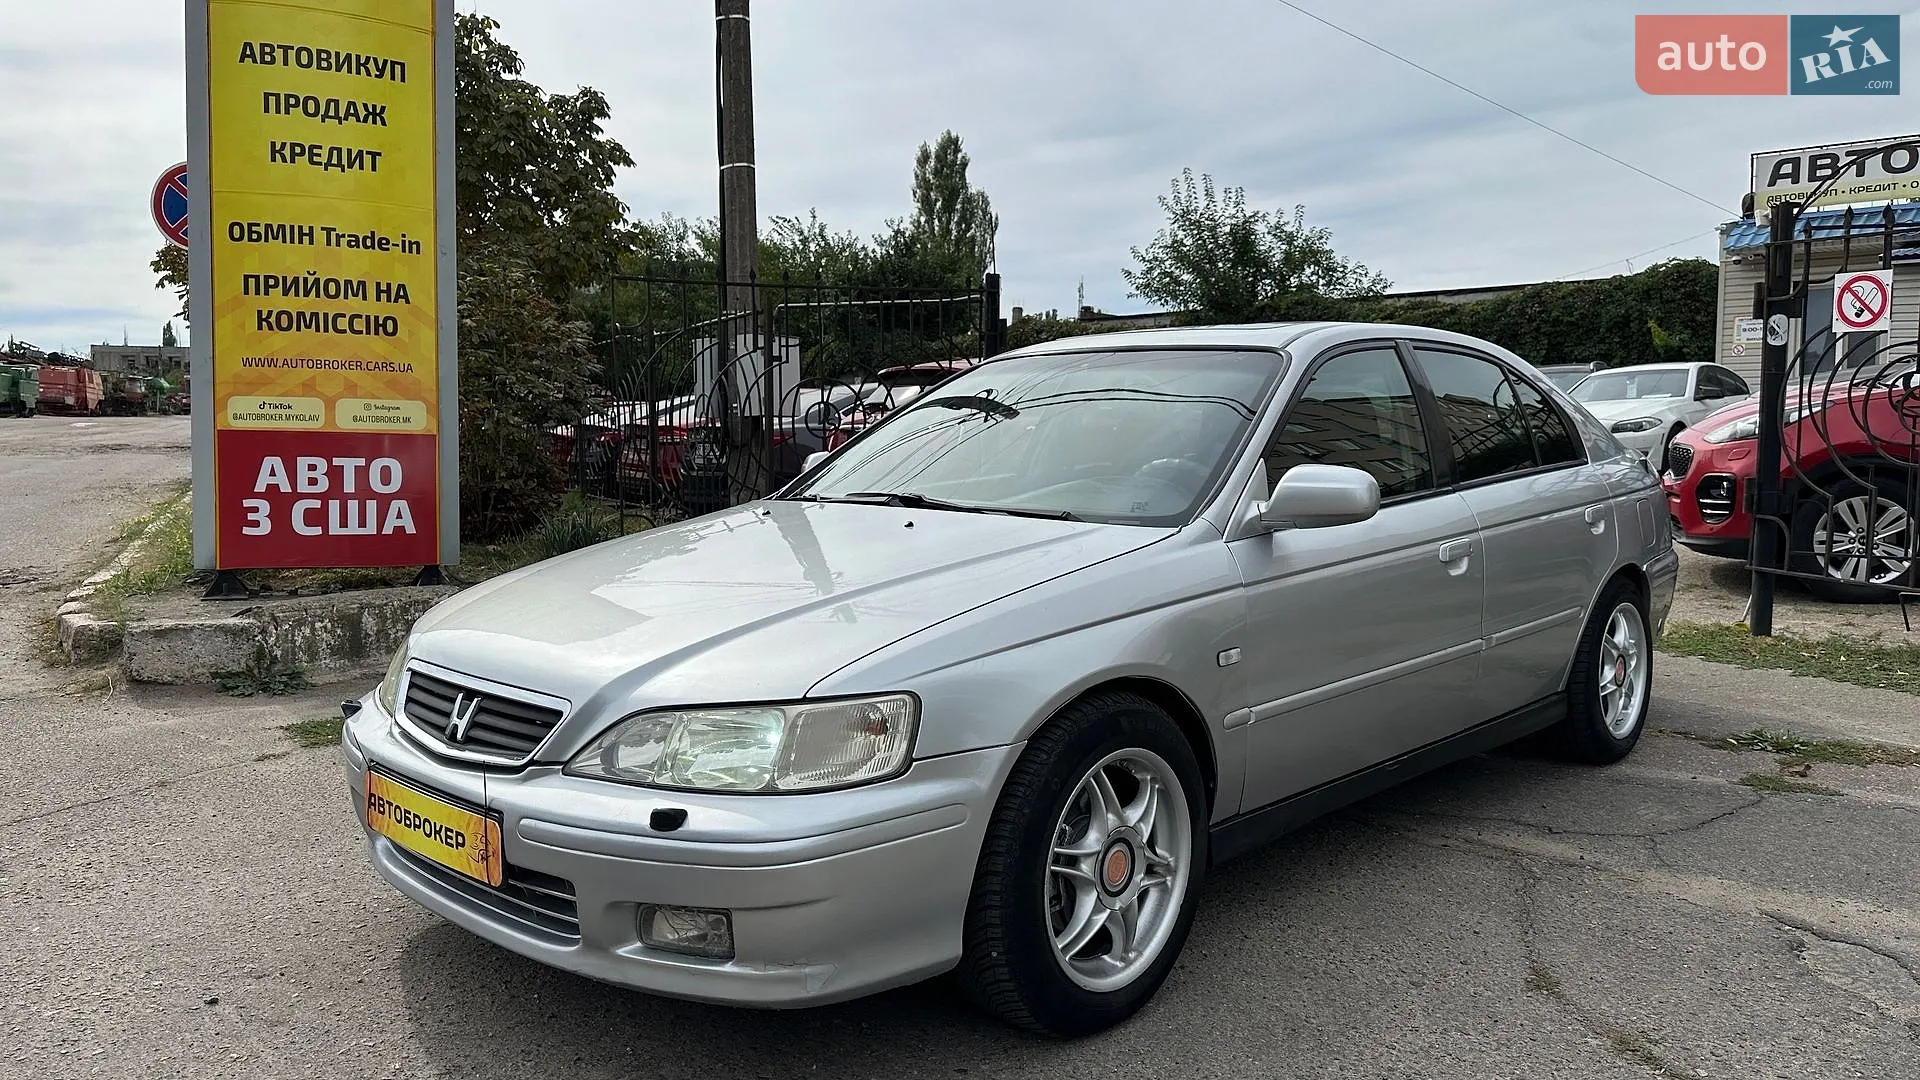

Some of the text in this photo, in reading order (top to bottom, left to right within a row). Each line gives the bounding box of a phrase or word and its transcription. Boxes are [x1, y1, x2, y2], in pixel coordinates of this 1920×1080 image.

[238, 41, 407, 84] АВТОВИКУП
[262, 91, 389, 127] ПРОДАЖ
[269, 141, 383, 174] КРЕДИТ
[1767, 145, 1920, 187] АВТО
[1849, 182, 1899, 194] КРЕДИТ
[228, 221, 421, 255] ОБМІН Trade-in
[243, 270, 411, 305] ПРИЙОМ НА
[256, 309, 399, 337] КОМІССІЮ
[241, 357, 414, 374] WWW.AUTOBROKER.CARS.UA
[232, 412, 320, 422] @AUTOBROKER.MYKOLAIV
[268, 402, 293, 410] TikTok
[352, 414, 412, 424] @AUTOBROKER.MK
[254, 456, 403, 494] АВТО
[242, 499, 417, 537] З США
[368, 792, 466, 851] АВТОБРОКЕР
